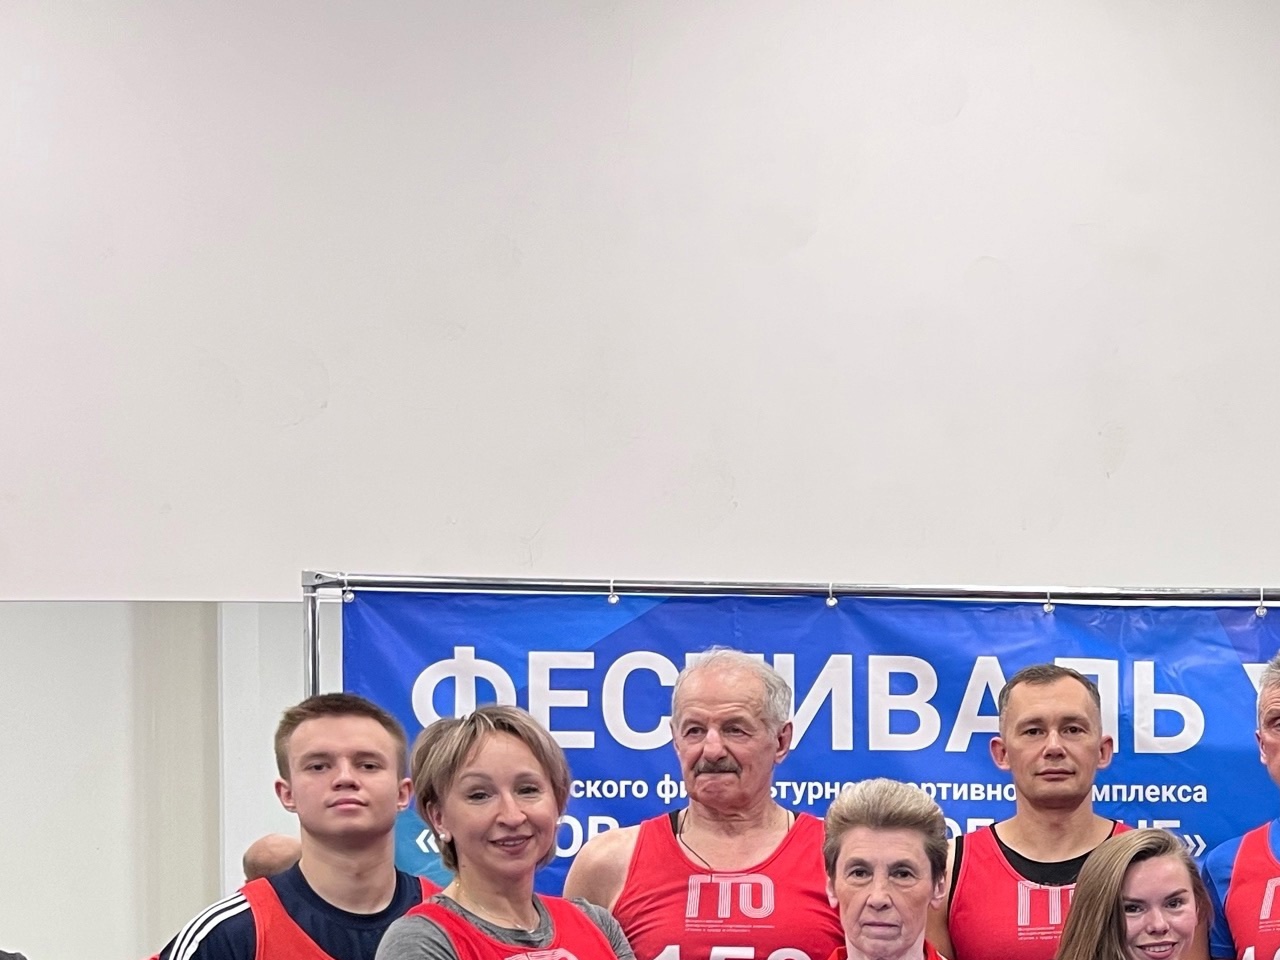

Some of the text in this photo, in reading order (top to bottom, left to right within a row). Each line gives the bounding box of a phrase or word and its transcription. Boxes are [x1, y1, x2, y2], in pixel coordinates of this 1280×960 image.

[411, 646, 1205, 754] ФЕСИВАЛЬ
[1091, 784, 1207, 802] мплекса
[686, 873, 775, 918] ГТО
[1018, 880, 1077, 926] ГТ
